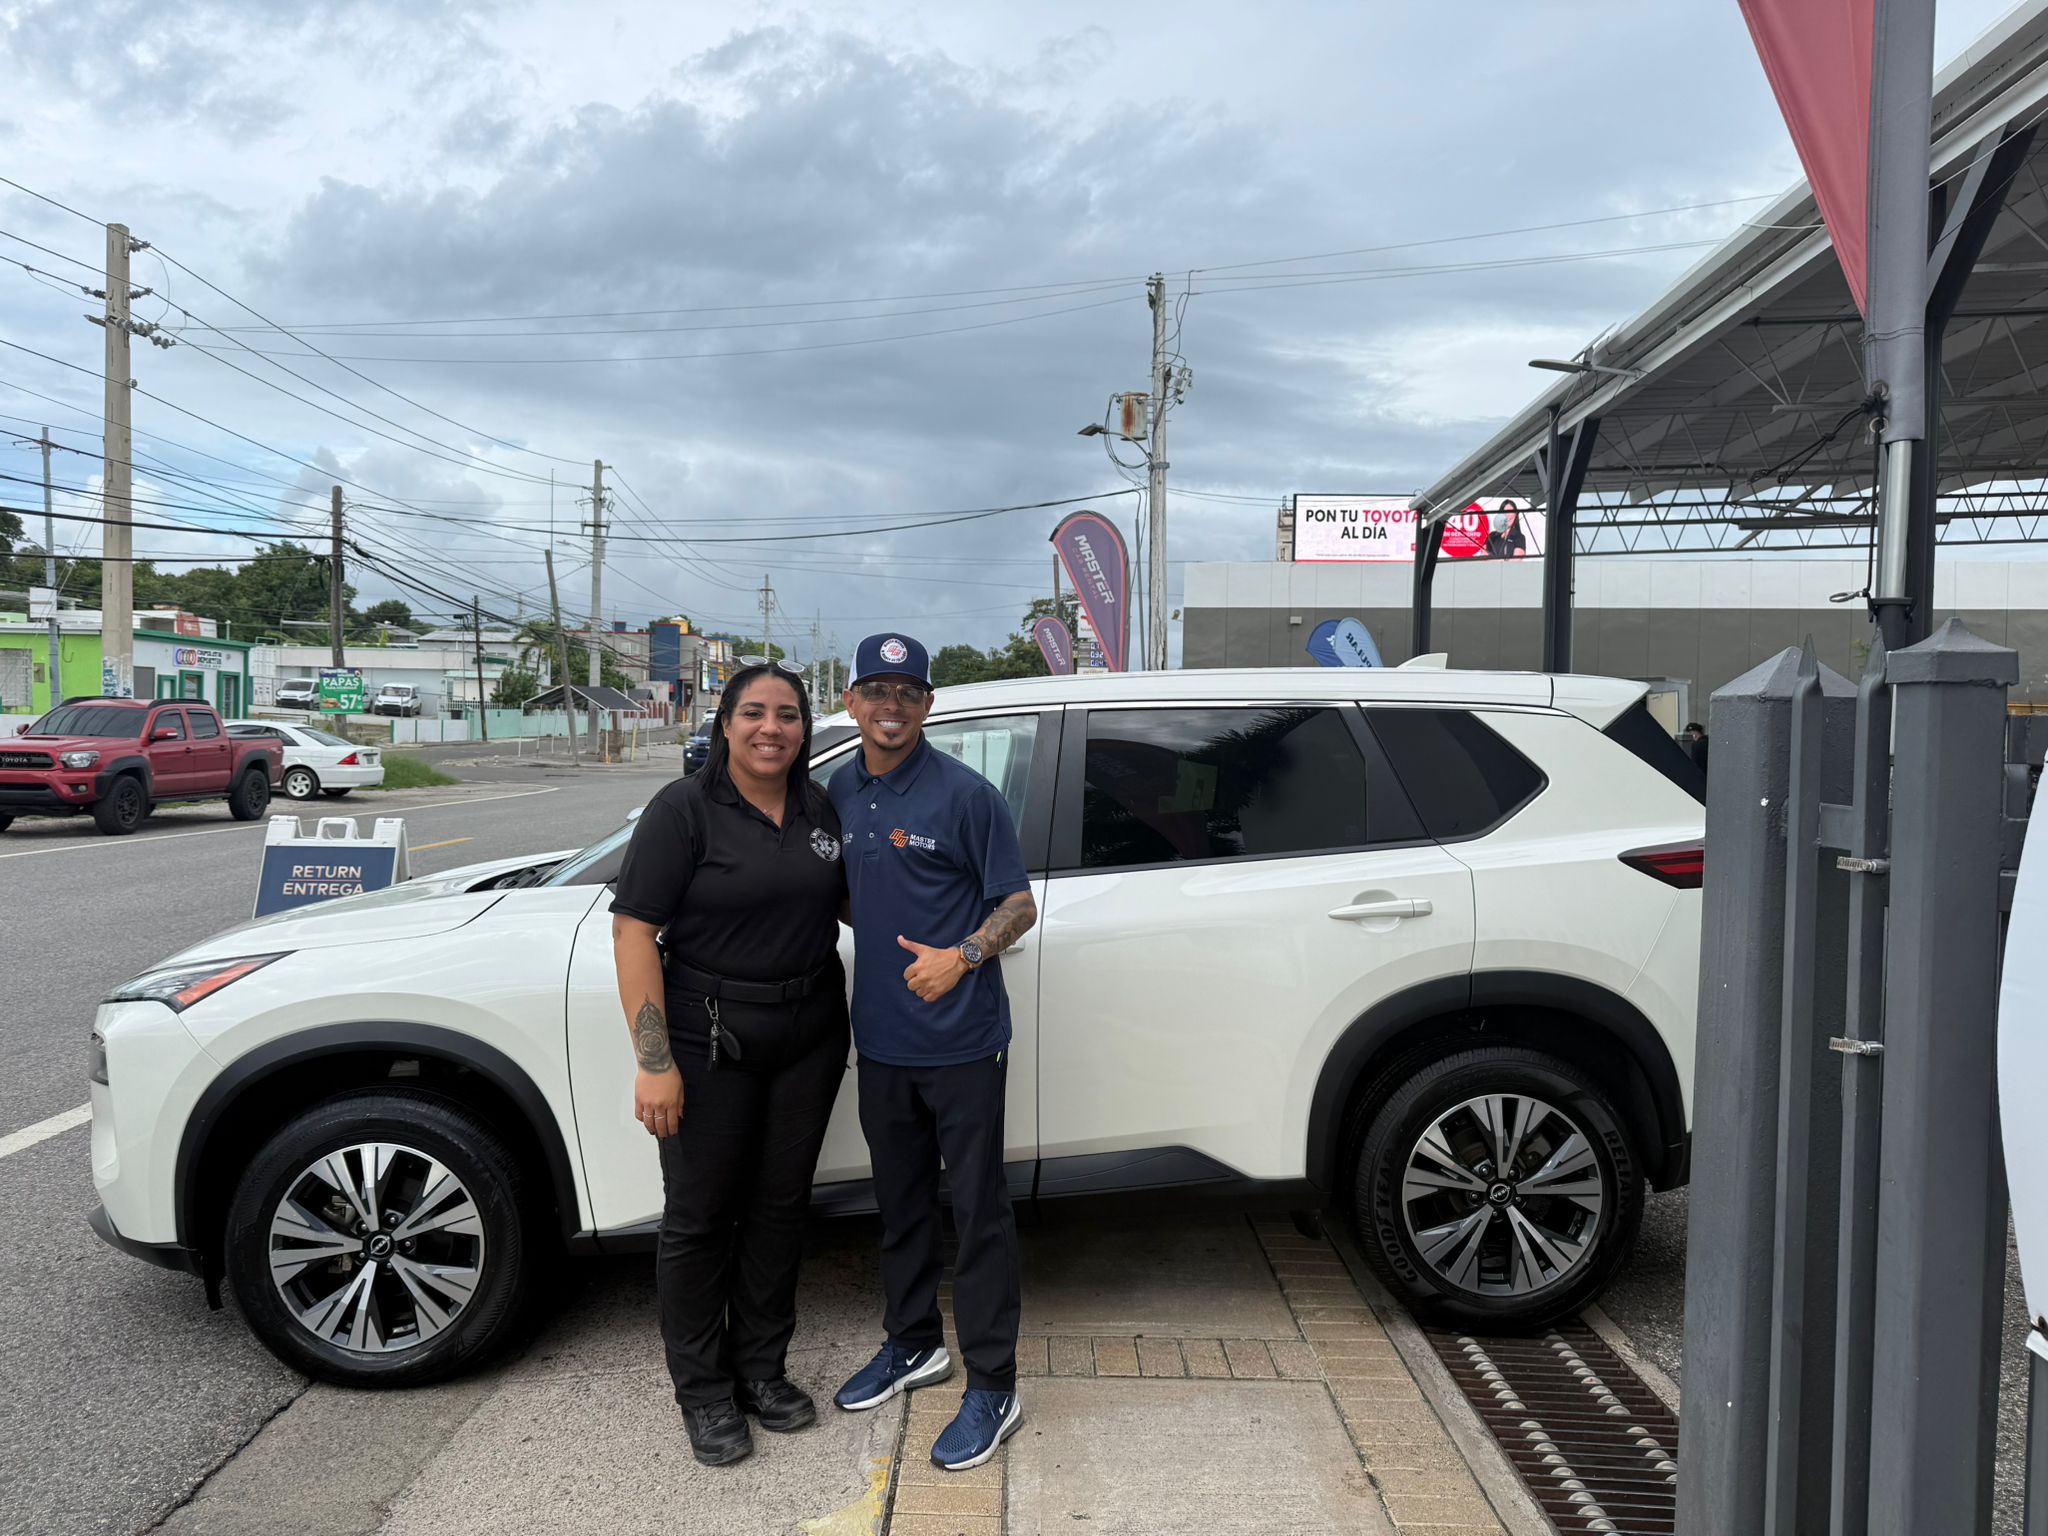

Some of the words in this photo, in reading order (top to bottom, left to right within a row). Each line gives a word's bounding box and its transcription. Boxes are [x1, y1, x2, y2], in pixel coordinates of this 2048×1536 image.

[1305, 509, 1336, 523] PON
[1340, 509, 1358, 523] TU
[1362, 509, 1420, 523] TOYOTA
[1341, 526, 1359, 539] AL
[1362, 522, 1388, 540] DÍA
[1074, 534, 1115, 604] MASTER
[1043, 627, 1066, 667] MASTER
[323, 677, 360, 687] PAPAS
[908, 839, 936, 850] MOTORS
[909, 833, 936, 844] MASTER
[292, 865, 362, 879] RETURN
[282, 882, 364, 897] ENTREGA
